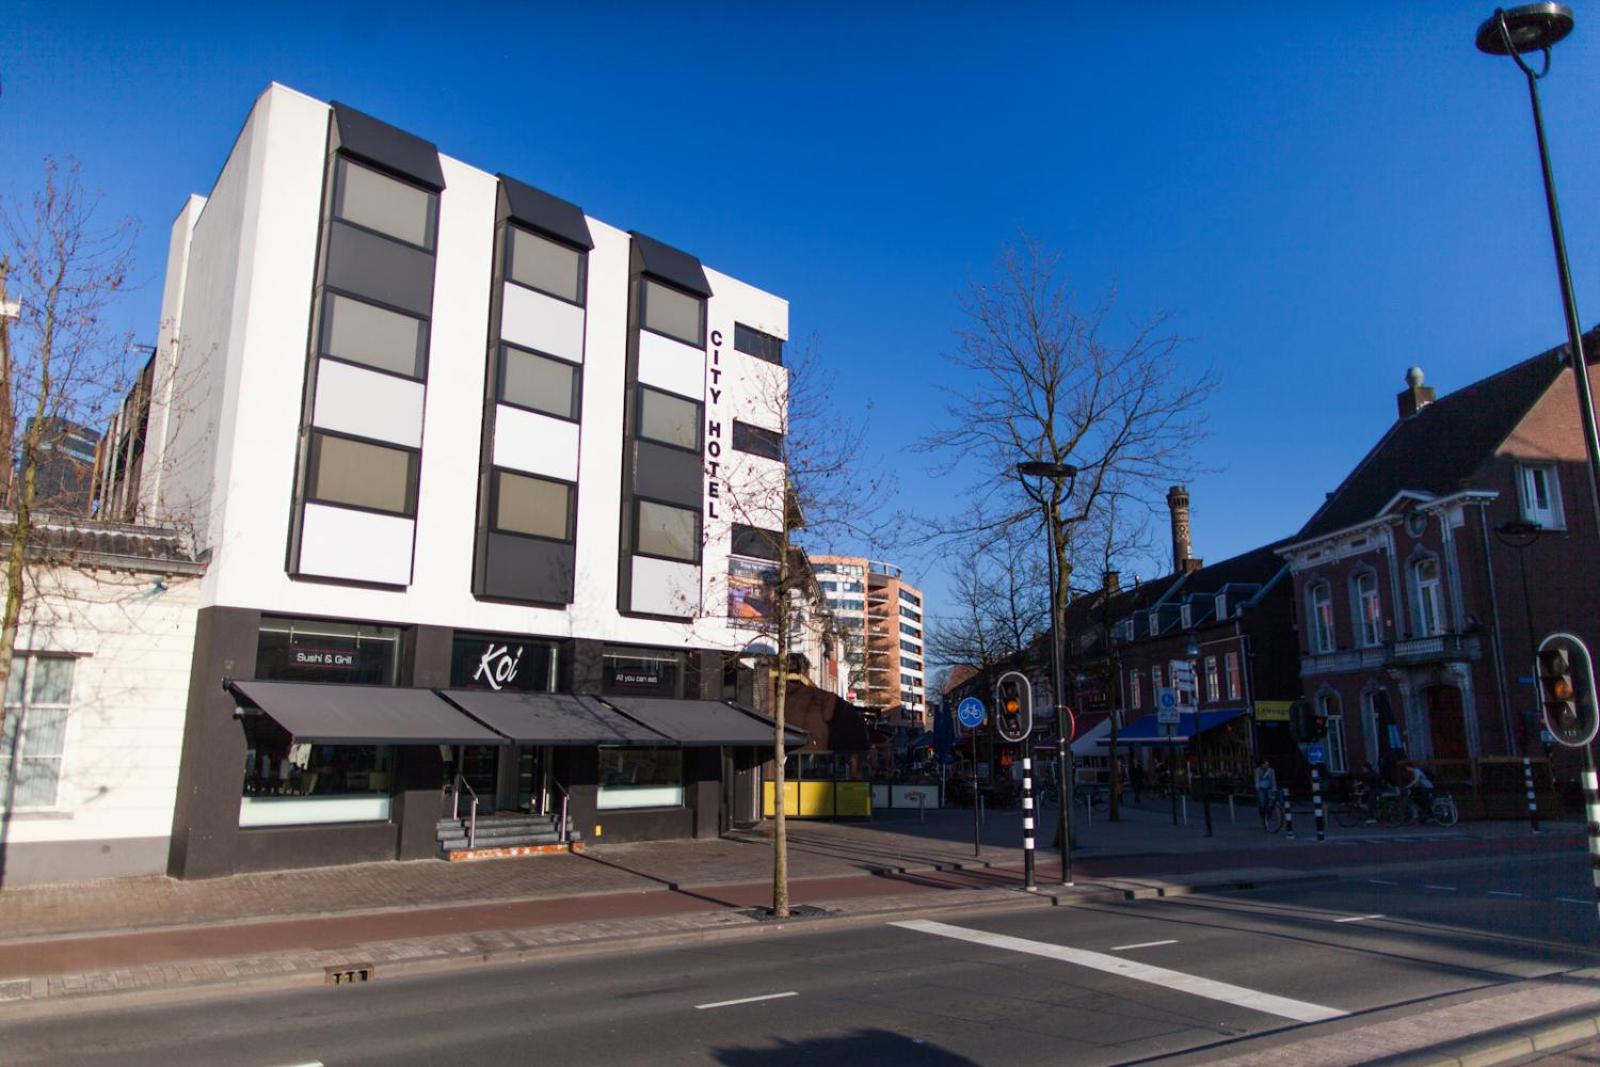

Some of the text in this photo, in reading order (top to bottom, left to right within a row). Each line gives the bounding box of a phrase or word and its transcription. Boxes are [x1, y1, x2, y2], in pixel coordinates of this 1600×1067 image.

[708, 330, 723, 519] CITY HOTEL
[296, 652, 353, 665] Sushi & Grill
[472, 643, 524, 690] Koi
[624, 675, 636, 683] you
